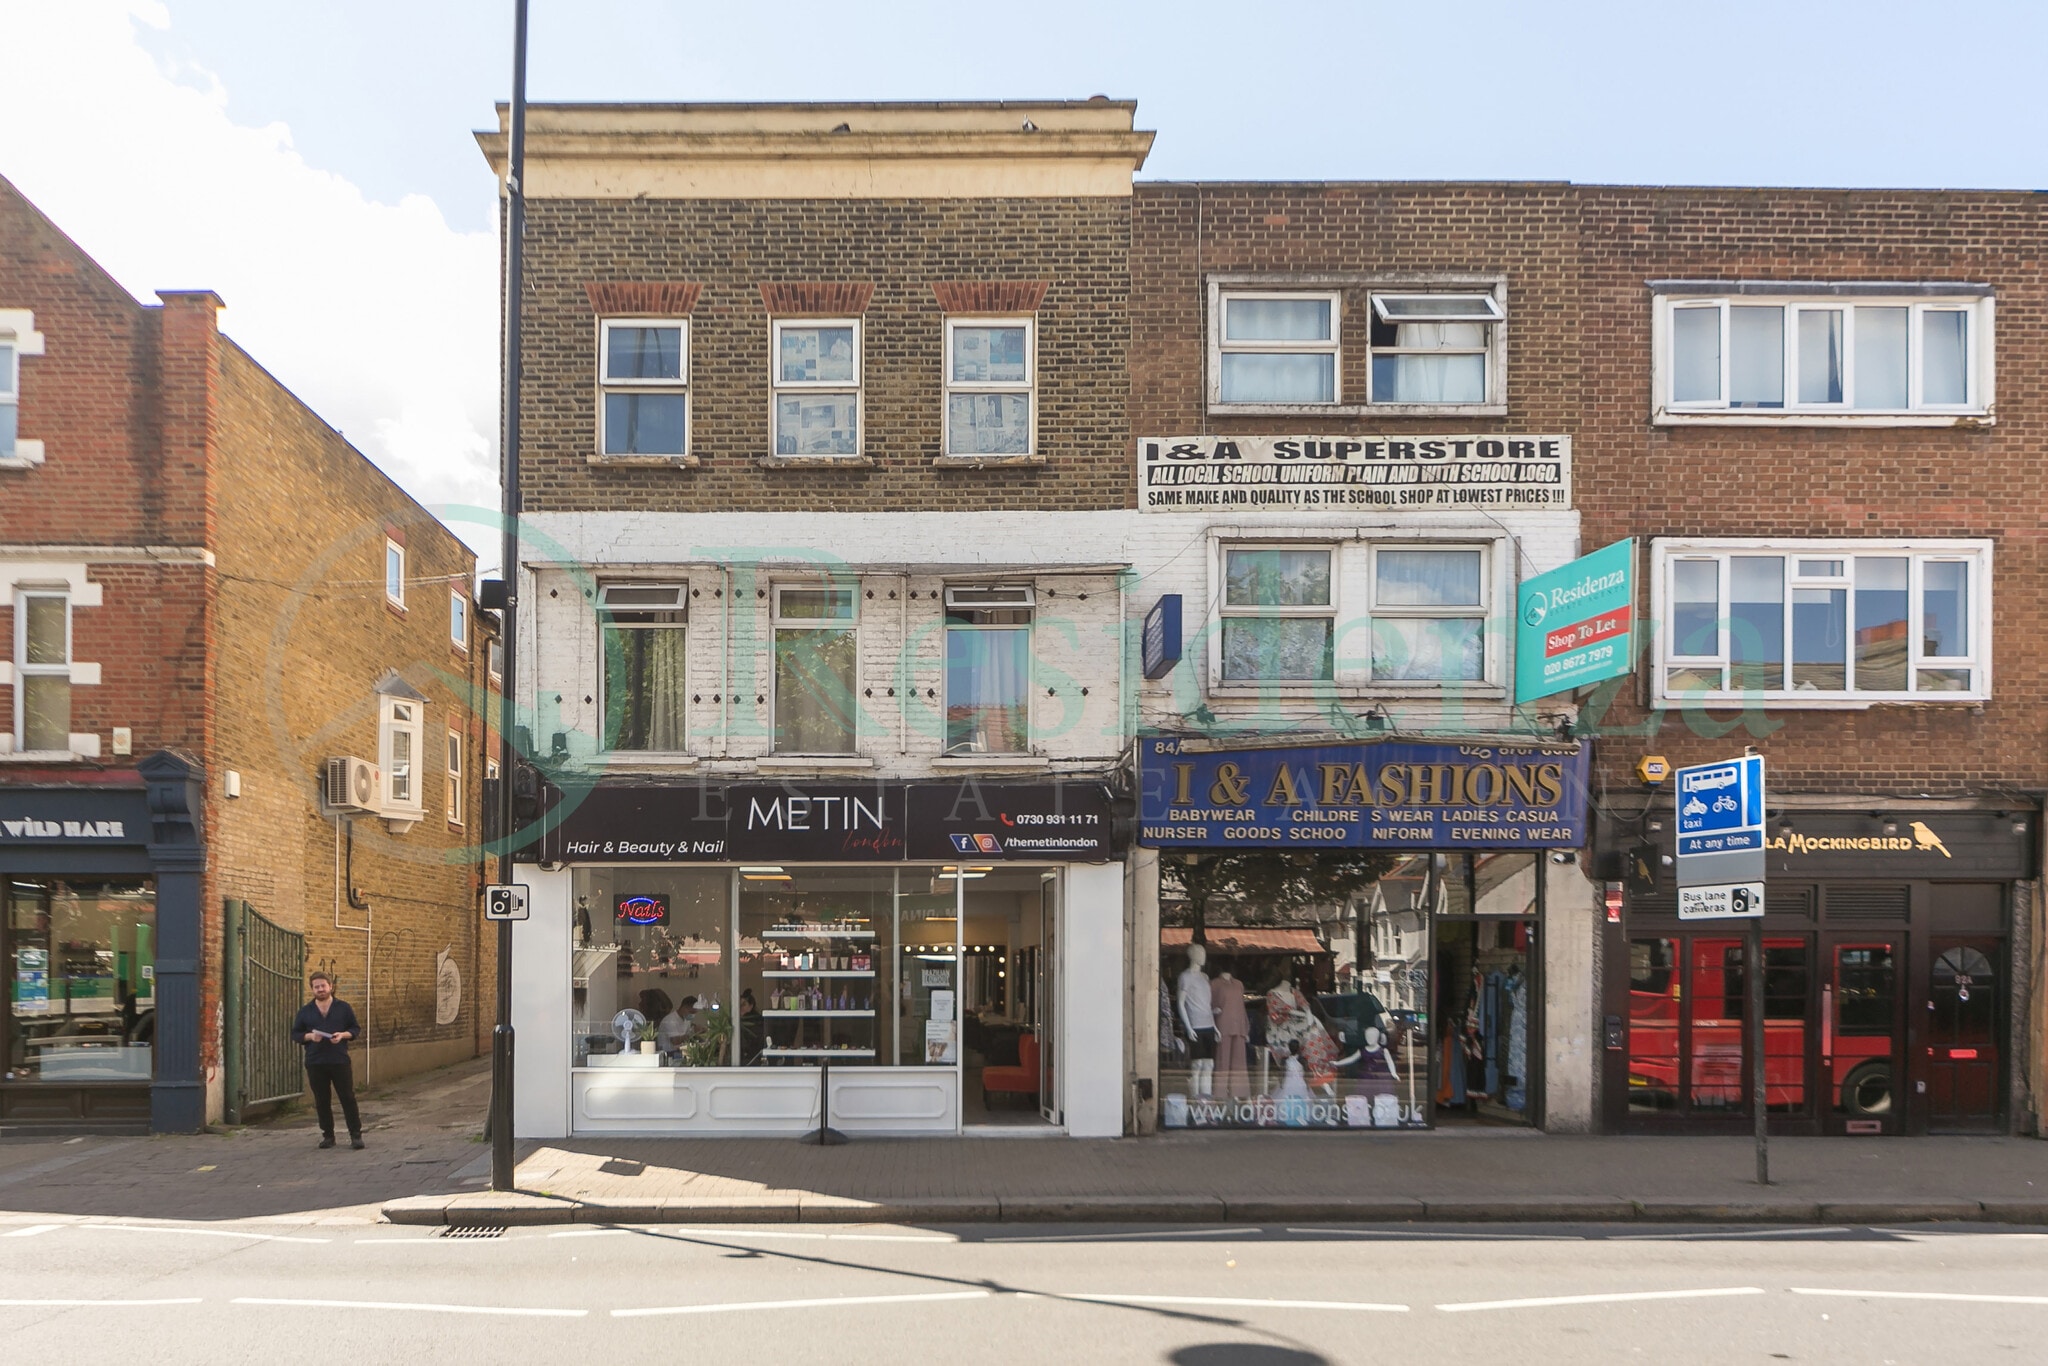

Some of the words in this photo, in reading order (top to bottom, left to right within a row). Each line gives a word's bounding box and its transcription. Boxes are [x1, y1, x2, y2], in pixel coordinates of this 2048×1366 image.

[1273, 440, 1561, 461] SUPERSTORE
[1151, 466, 1175, 484] ALL
[1178, 466, 1219, 484] LOCAL
[1222, 465, 1278, 484] SCHOOL
[1280, 465, 1344, 483] UNIFORM
[1346, 465, 1388, 483] PLAIN
[1389, 464, 1420, 483] AND
[1421, 464, 1460, 483] WITH
[1461, 464, 1517, 482] SCHOOL
[1519, 464, 1559, 482] LOGO.
[1148, 491, 1183, 505] SAME
[1185, 491, 1219, 505] MAKE
[1222, 491, 1248, 505] AND
[1250, 490, 1300, 505] QUALITY
[1303, 490, 1320, 505] AS
[1323, 490, 1346, 505] THE
[1348, 490, 1397, 504] SCHOOL
[1400, 490, 1434, 504] SHOP
[1436, 490, 1450, 504] AT
[1453, 489, 1503, 504] LOWEST
[1506, 489, 1550, 504] PRICES
[1550, 569, 1625, 609] Residenza
[1548, 634, 1575, 649] Shop
[1578, 625, 1593, 640] To
[1596, 618, 1616, 634] Let
[1544, 663, 1561, 677] 020
[1563, 653, 1586, 670] 8672
[1589, 645, 1613, 662] 7979
[1172, 763, 1194, 805] I
[1210, 763, 1250, 806] &
[1263, 763, 1302, 806] A
[1317, 763, 1563, 807] FASHIONS
[748, 796, 883, 830] METIN
[1016, 814, 1044, 825] 0730
[1046, 814, 1066, 825] 931
[1069, 814, 1082, 825] 11
[1085, 814, 1099, 825] 71
[1169, 809, 1256, 822] BABYWEAR
[1389, 810, 1434, 822] WEAR
[1442, 810, 1499, 823] LADIES
[1505, 810, 1559, 822] CASUA
[63, 820, 125, 838] HARE
[1683, 818, 1703, 829] taxi
[1143, 826, 1208, 839] NURSER
[1224, 827, 1282, 839] GOODS
[1289, 827, 1347, 839] SCHOO
[1451, 827, 1521, 840] EVENING
[1527, 827, 1573, 840] WEAR
[566, 841, 600, 854] Hair
[603, 841, 614, 854] &
[617, 841, 675, 856] Beauty
[677, 841, 689, 854] &
[692, 840, 724, 854] Nail
[1004, 837, 1099, 848] /themetinlondon
[1689, 838, 1702, 850] At
[1704, 838, 1724, 850] any
[1726, 835, 1750, 847] time
[1788, 833, 1912, 855] MOCKINGBIRD
[1683, 892, 1701, 903] Bus
[1704, 891, 1726, 902] lane
[617, 900, 665, 919] Nails
[1683, 904, 1726, 914] cameras
